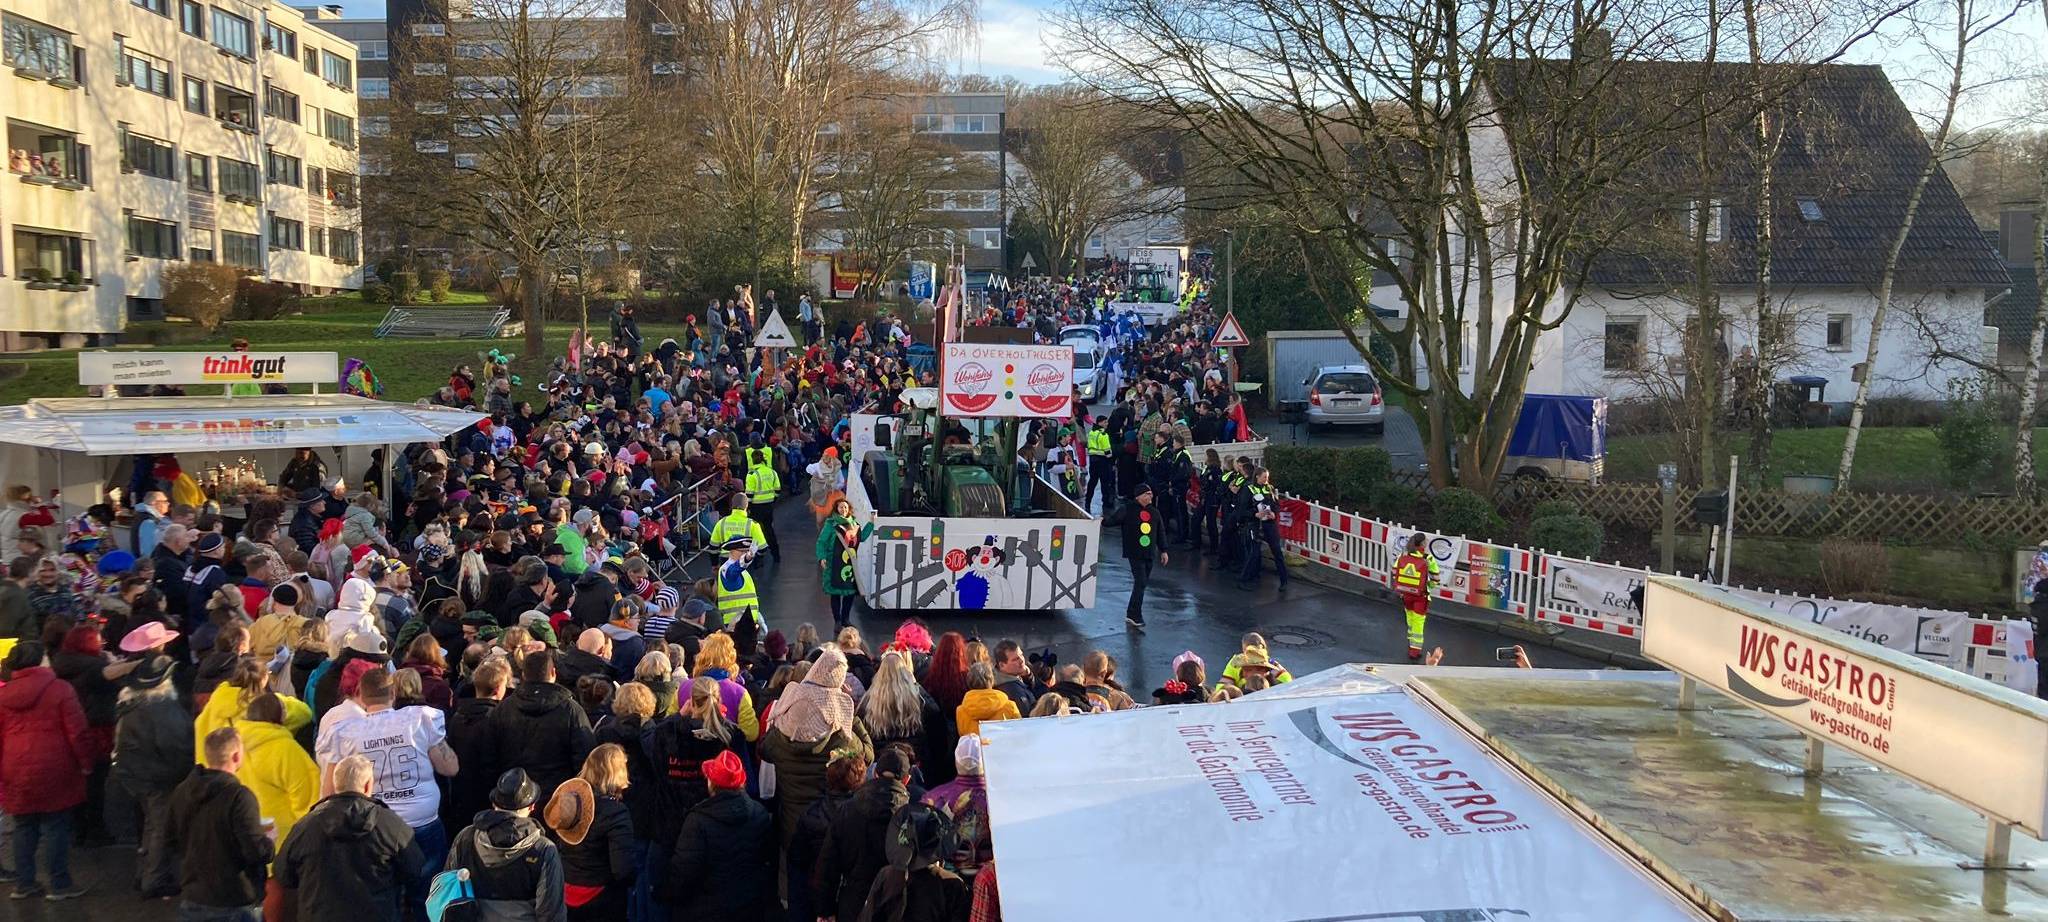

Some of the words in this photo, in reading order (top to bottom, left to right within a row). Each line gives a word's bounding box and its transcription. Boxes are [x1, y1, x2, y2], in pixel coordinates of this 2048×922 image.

[112, 361, 137, 370] mich
[139, 358, 165, 368] kann
[203, 355, 286, 379] trinkgut
[113, 373, 136, 381] man
[138, 369, 172, 379] mieten
[947, 551, 966, 568] STOP
[1739, 624, 1779, 678] WS
[1784, 641, 1886, 705] GASTRO
[1887, 678, 1896, 711] GmbH
[1781, 673, 1892, 731] Getränkefachgroßhandel
[1176, 724, 1215, 737] für
[1225, 720, 1266, 733] Ihr
[1810, 708, 1890, 754] ws-gastro.de
[363, 734, 404, 750] LIGHTNINGS
[1186, 741, 1228, 754] die
[1236, 735, 1317, 805] Servicepartner
[1332, 711, 1421, 742] WS
[1391, 744, 1518, 825] GASTRO
[1477, 823, 1531, 834] GmbH
[383, 789, 415, 800] GEIGER
[1196, 755, 1276, 822] Gastronomie
[1353, 772, 1430, 840] ws-gastro.de
